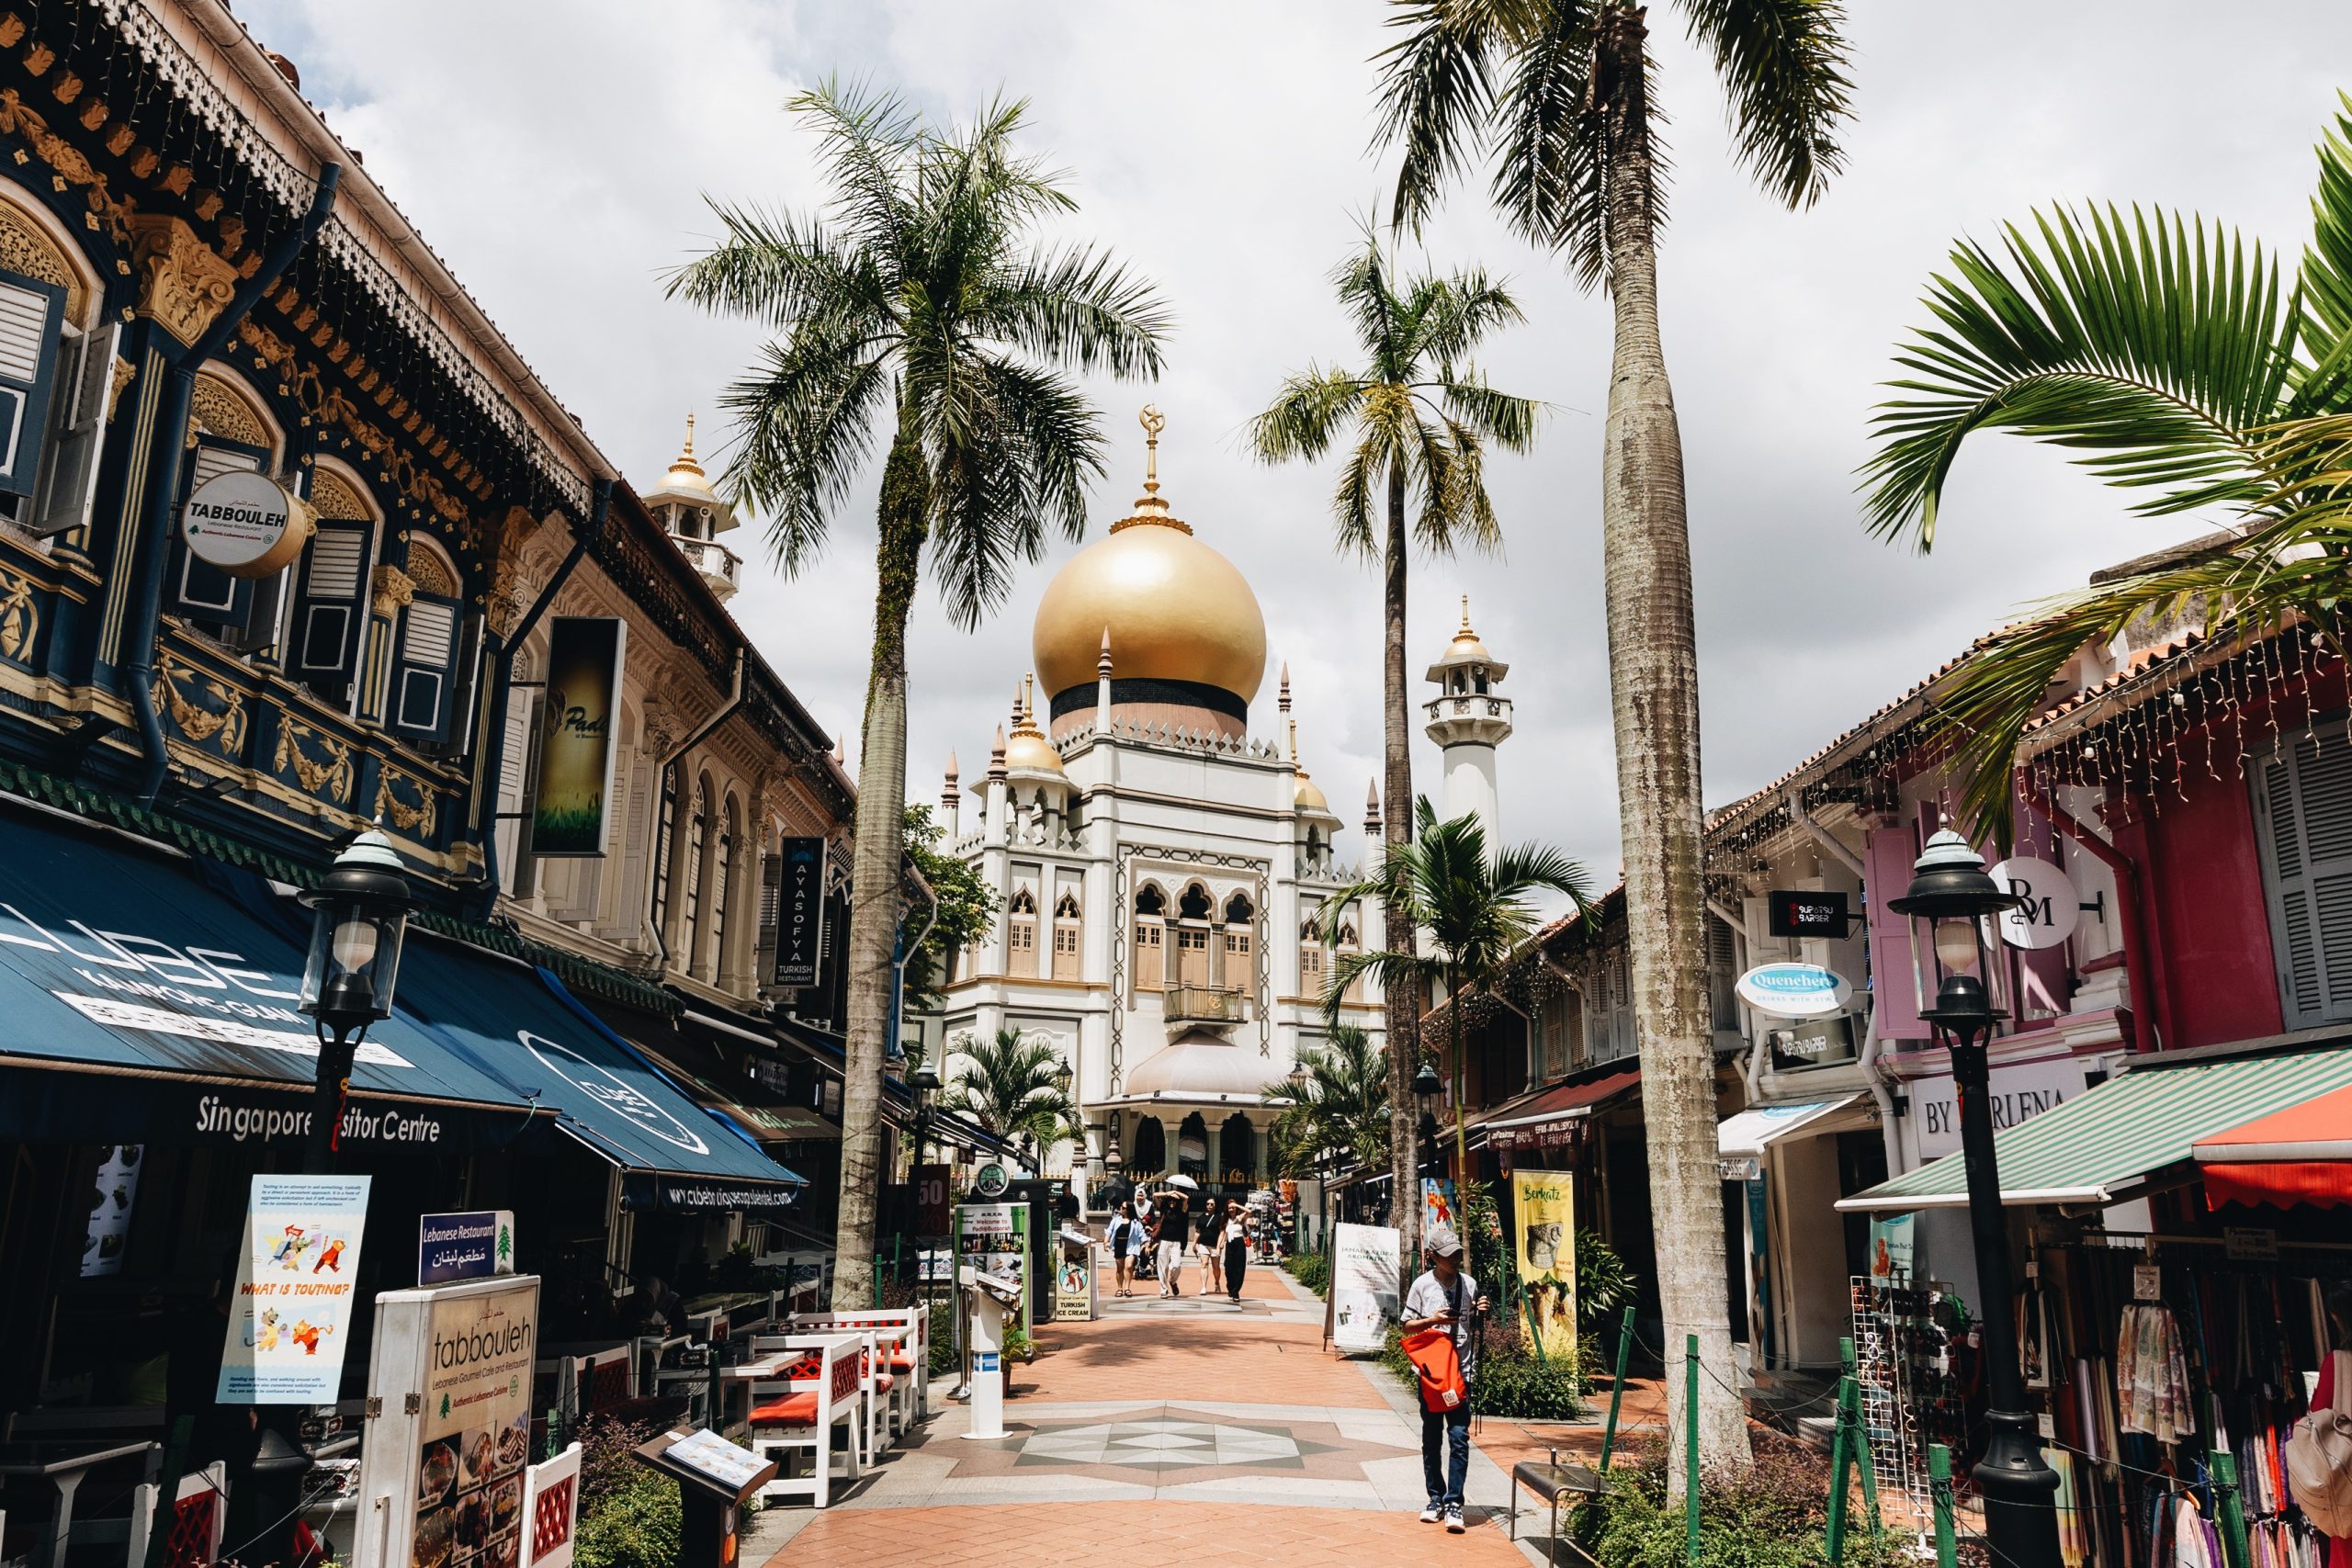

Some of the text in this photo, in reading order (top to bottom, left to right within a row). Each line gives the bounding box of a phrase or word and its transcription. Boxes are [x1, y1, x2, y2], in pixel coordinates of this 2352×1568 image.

[190, 502, 286, 527] TABBOULEH
[791, 864, 807, 961] AYASOFYA
[779, 965, 812, 974] TURKISH
[1754, 973, 1834, 987] Quenchers
[383, 1111, 440, 1142] Centre
[1926, 1101, 1951, 1134] BY
[1522, 1184, 1561, 1202] Berkatz
[424, 1224, 494, 1243] Lebanese Restaurant
[241, 1282, 350, 1295] WHAT IS TOUTING?
[435, 1315, 531, 1371] tabbouleh
[433, 1358, 529, 1391] Lebanese Gourmet Cafe and Restaurant
[453, 1396, 474, 1408] Authentic
[474, 1392, 493, 1403] Lebanese
[493, 1385, 508, 1395] Cuisine
